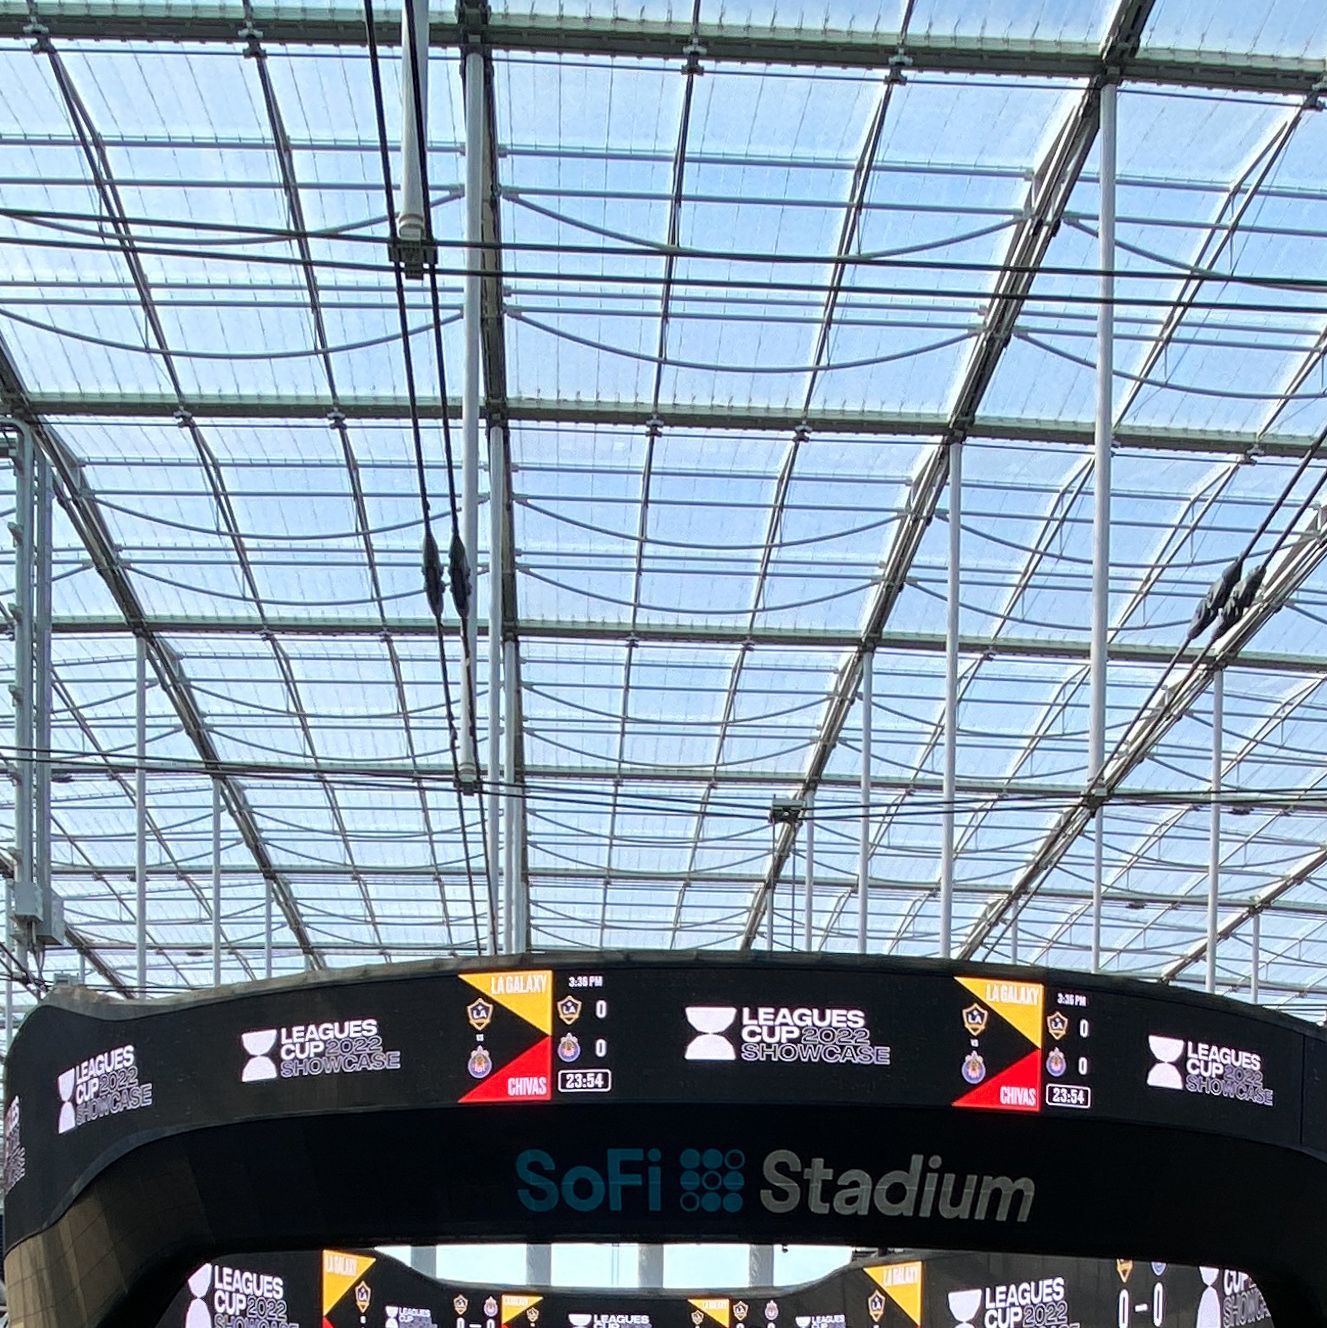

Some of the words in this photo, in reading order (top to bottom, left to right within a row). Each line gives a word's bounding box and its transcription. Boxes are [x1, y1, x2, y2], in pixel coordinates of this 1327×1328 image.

[491, 976, 503, 994] LA
[505, 975, 547, 993] GALAXY
[589, 976, 603, 987] PM
[595, 1000, 607, 1018] 0
[1075, 994, 1087, 1007] PM
[741, 1006, 865, 1028] LEAGUES
[1079, 1019, 1089, 1038] 0
[280, 1019, 378, 1044] LEAGUES
[741, 1025, 801, 1044] CUP
[801, 1027, 870, 1045] 2022
[280, 1041, 325, 1061] CUP
[325, 1036, 383, 1056] 2022
[595, 1039, 607, 1057] 0
[741, 1042, 891, 1065] SHOWCASE
[1187, 1040, 1262, 1071] LEAGUES
[76, 1045, 135, 1084] LEAGUES
[280, 1051, 401, 1078] SHOWCASE
[1078, 1056, 1088, 1075] 0
[1186, 1058, 1224, 1079] CUP
[1224, 1064, 1264, 1088] 2022
[76, 1077, 100, 1105] CUP
[99, 1066, 139, 1096] 2022
[508, 1077, 547, 1096] CHIVAS
[565, 1073, 604, 1089] 23:54
[1185, 1074, 1273, 1106] SHOWCASE
[76, 1083, 153, 1126] SHOWCASE
[1000, 1085, 1037, 1106] CHIVAS
[1052, 1087, 1085, 1105] 23:54
[516, 1148, 662, 1213] SoFi
[760, 1149, 1035, 1222] Stadium
[214, 1264, 283, 1299] LEAGUES
[985, 1276, 1065, 1309] LEAGUES
[214, 1293, 246, 1315] CUP
[246, 1296, 287, 1322] 2022
[1022, 1300, 1068, 1328] 2022
[1153, 1282, 1163, 1328] 0
[593, 1314, 650, 1324] LEAGUES
